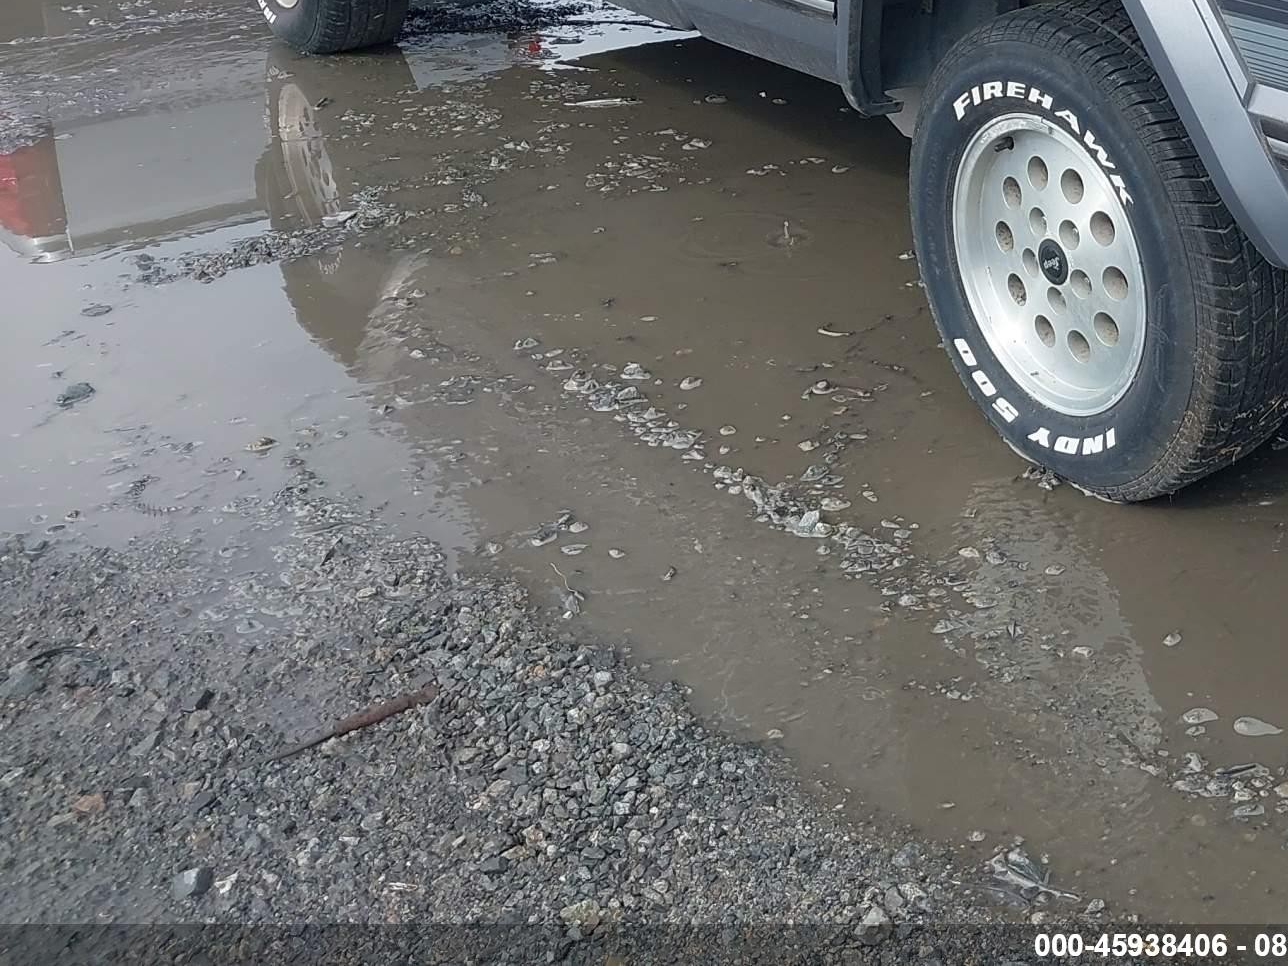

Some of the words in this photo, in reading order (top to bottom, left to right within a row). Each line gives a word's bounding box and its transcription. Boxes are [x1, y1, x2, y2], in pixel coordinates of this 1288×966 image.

[952, 80, 1135, 206] FIREHAWK
[953, 337, 1020, 424] 500
[1027, 425, 1116, 456] INDY
